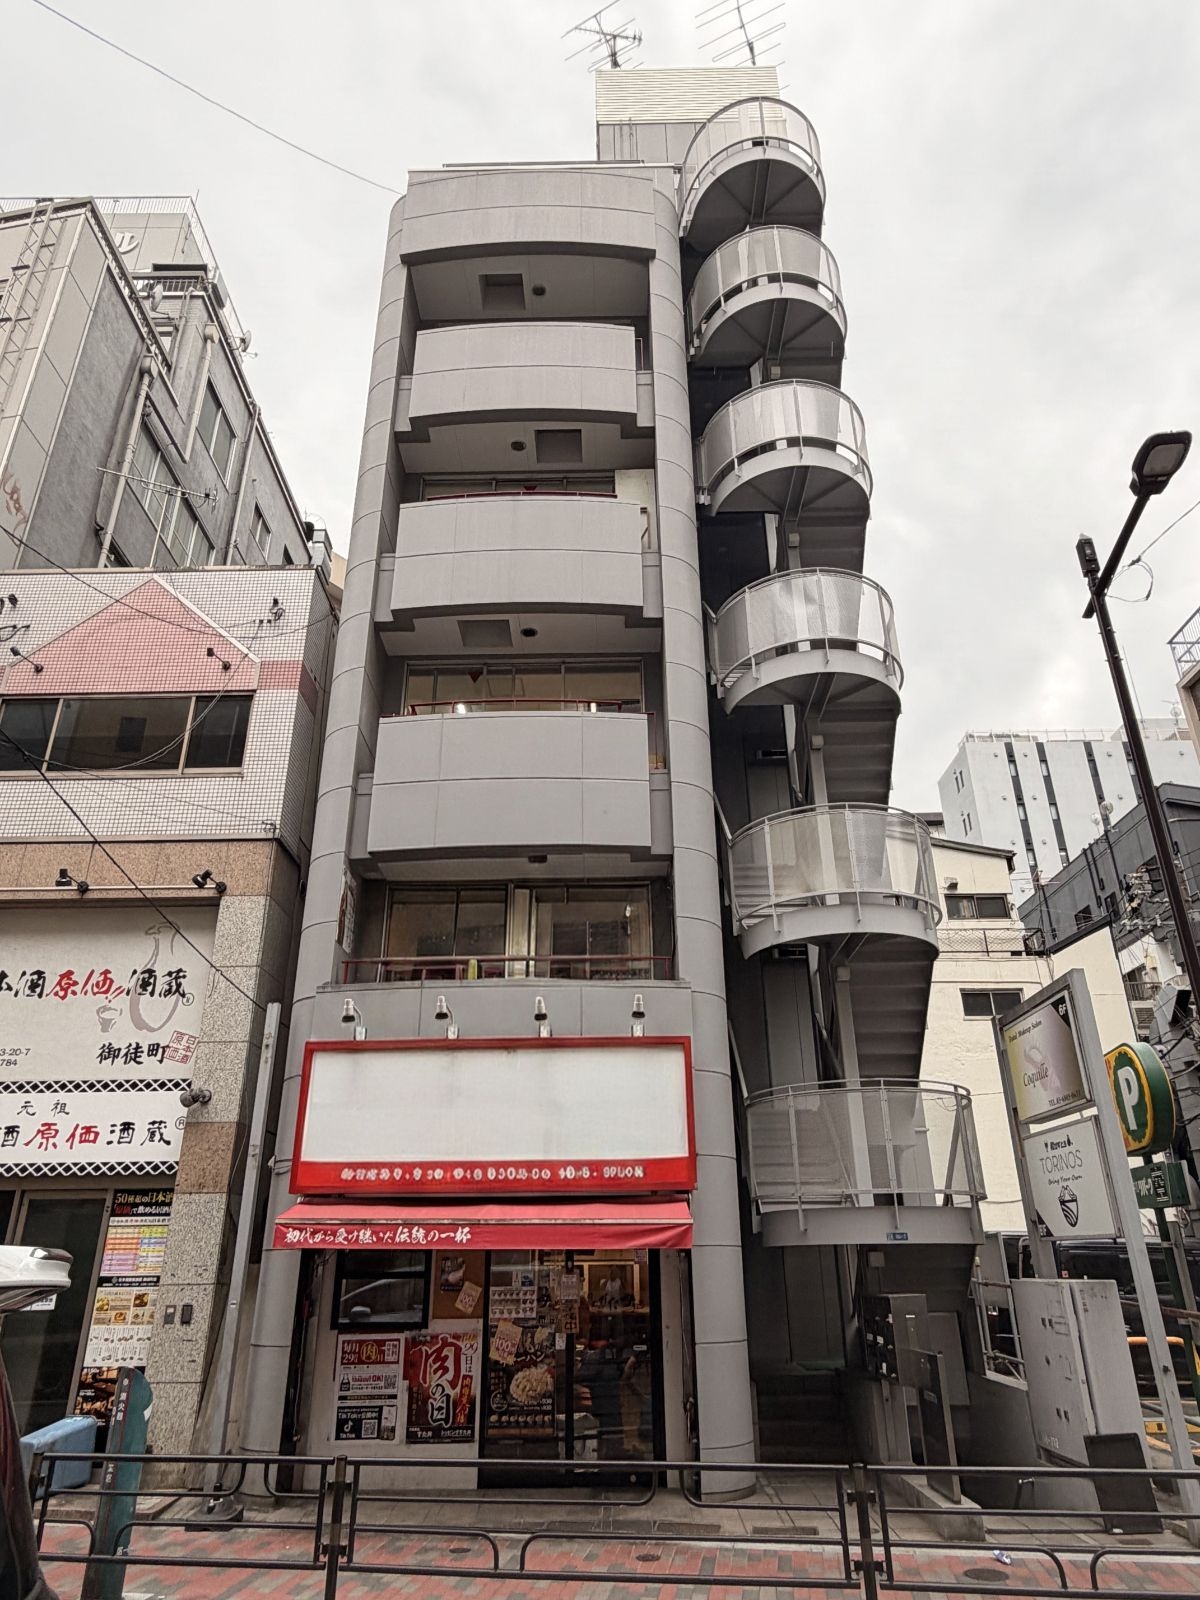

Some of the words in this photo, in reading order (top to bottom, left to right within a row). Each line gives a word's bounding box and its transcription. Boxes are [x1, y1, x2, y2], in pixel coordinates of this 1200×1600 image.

[1058, 1003, 1067, 1016] 6F
[96, 1041, 170, 1066] 御徒町
[1117, 1065, 1139, 1131] P
[1039, 1149, 1083, 1175] TORINOS
[283, 1225, 473, 1244] 初代から受け継いだ伝統の一杯
[419, 1334, 463, 1427] 肉の日
